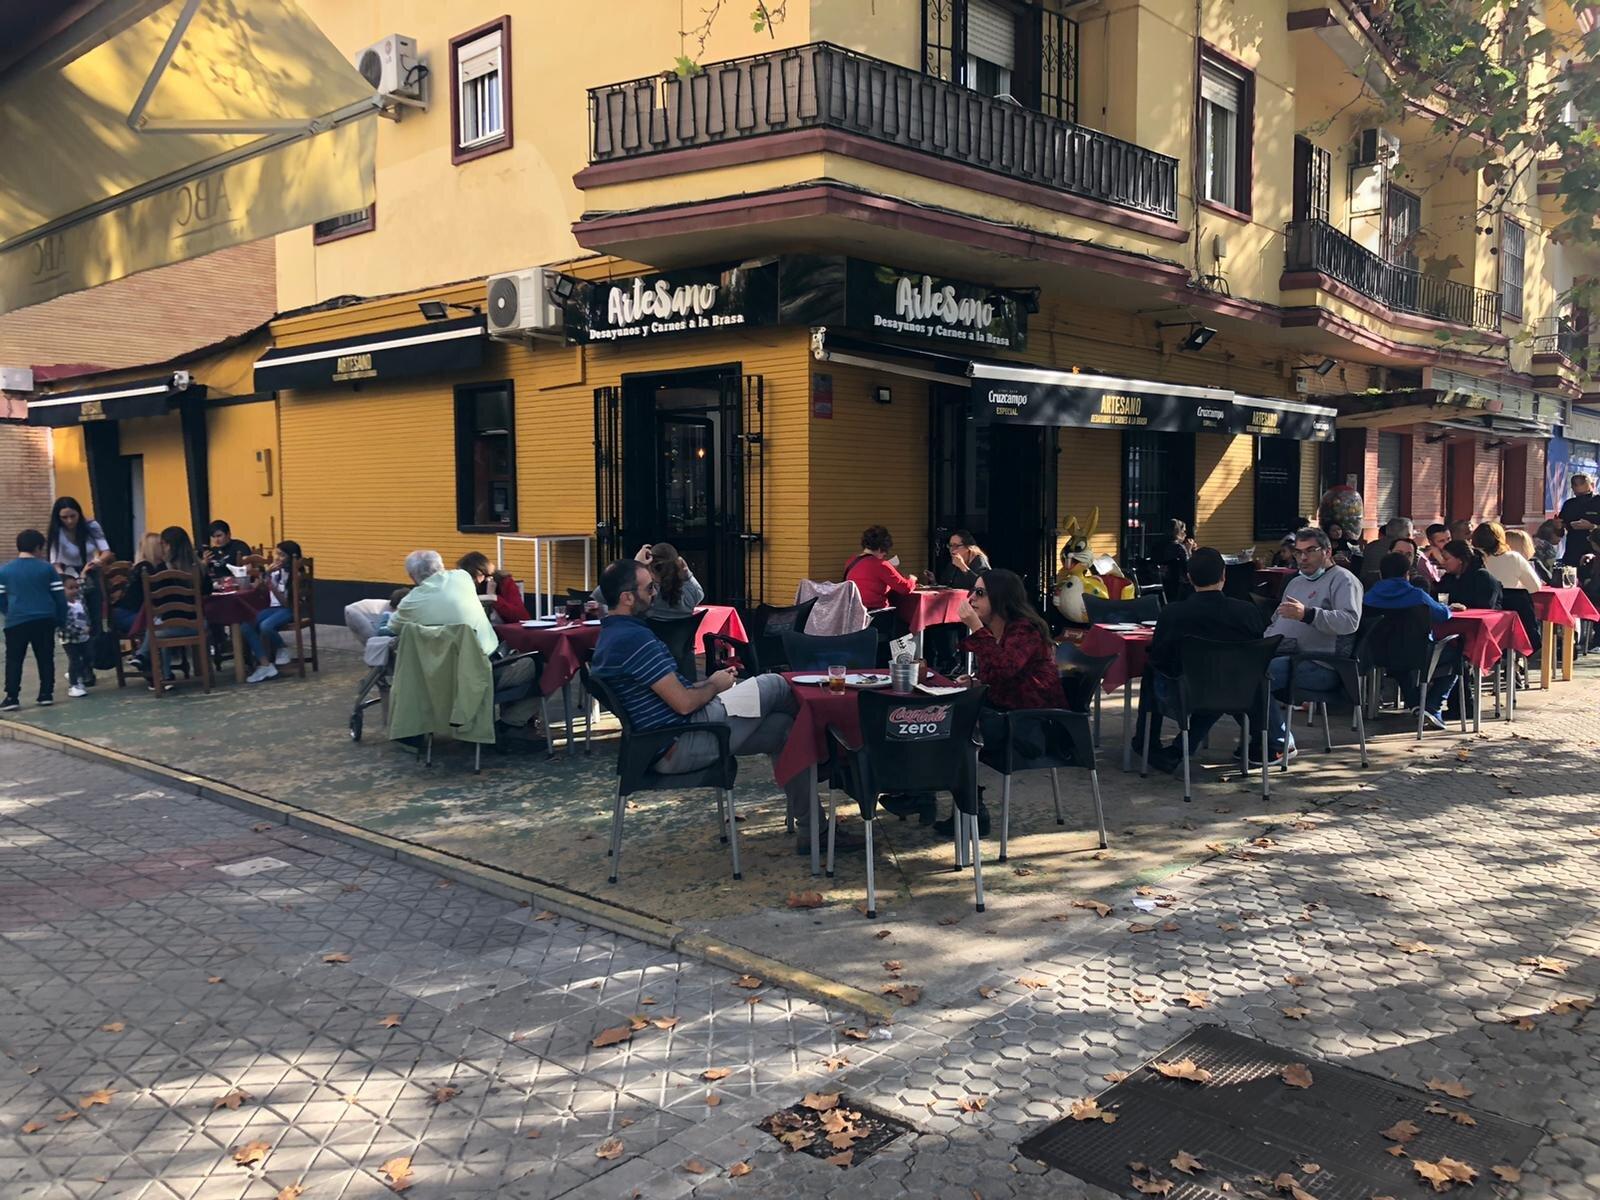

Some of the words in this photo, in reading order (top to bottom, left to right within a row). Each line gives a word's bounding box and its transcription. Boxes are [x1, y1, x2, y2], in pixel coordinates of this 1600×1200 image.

[589, 327, 640, 340] Desayunos
[642, 325, 649, 337] y
[651, 321, 687, 333] Carnes
[689, 319, 696, 328] a
[698, 316, 709, 327] la
[712, 314, 744, 326] Brasa
[874, 315, 925, 332] Desayunos
[927, 327, 934, 336] y
[935, 325, 966, 340] Carnes
[968, 331, 974, 340] a
[976, 331, 985, 342] la
[986, 333, 1010, 346] Brasa
[988, 390, 1028, 406] Cruzcampo
[1100, 395, 1141, 415] ARTESANO
[899, 723, 937, 734] zero
